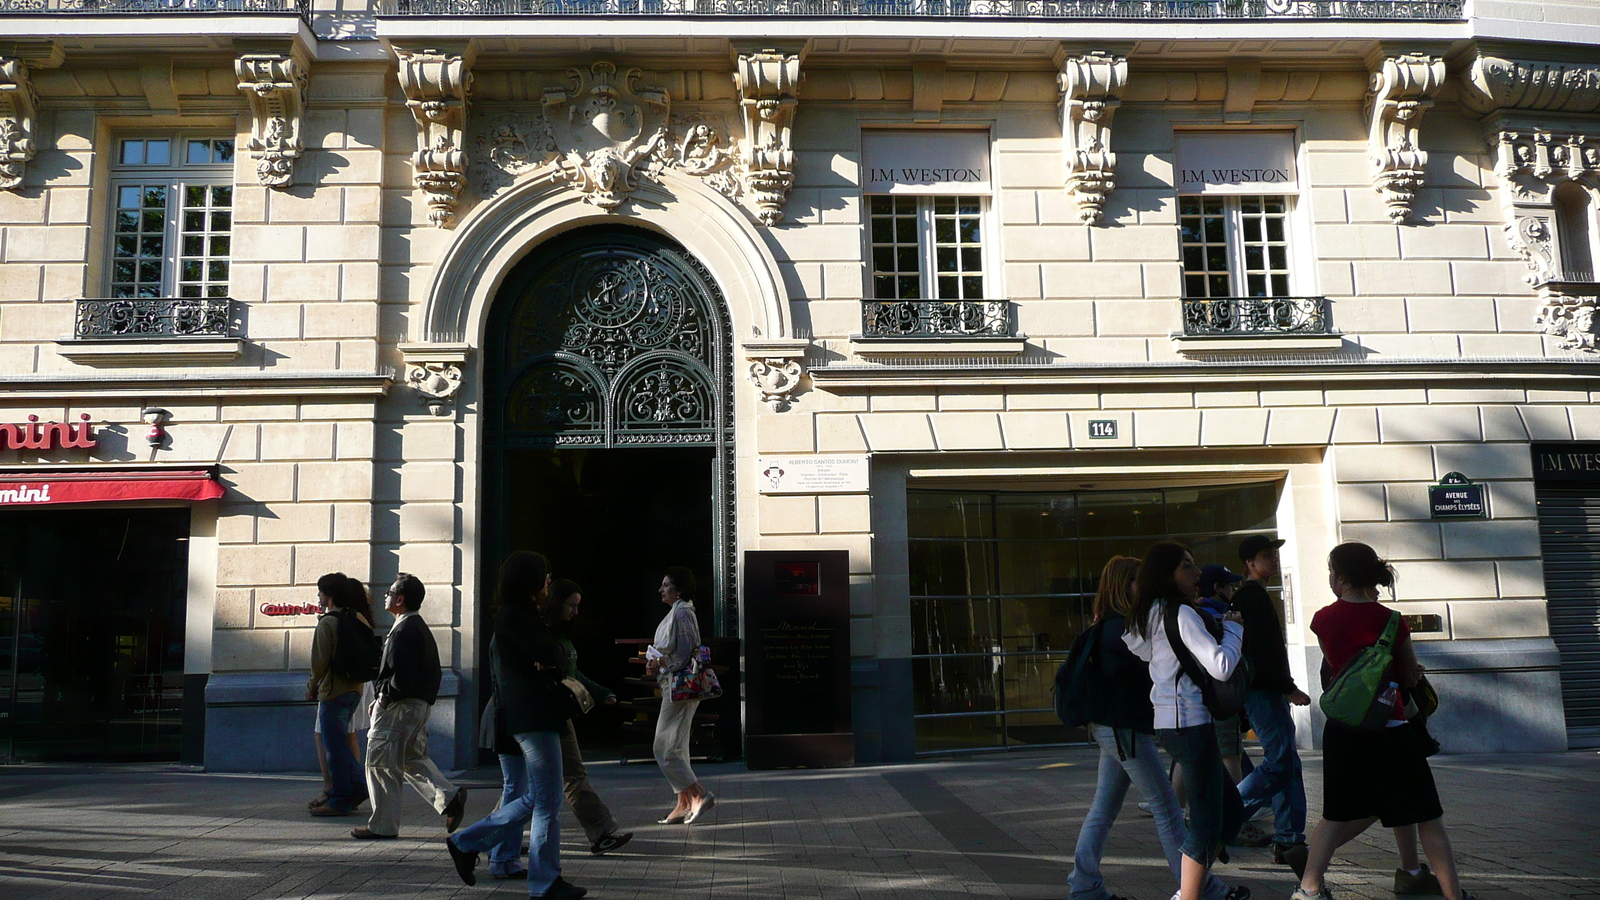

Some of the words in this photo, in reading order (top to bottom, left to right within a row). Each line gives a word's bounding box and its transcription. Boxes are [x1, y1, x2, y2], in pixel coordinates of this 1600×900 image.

[870, 168, 899, 183] J.M.
[902, 168, 981, 182] WESTON
[1181, 169, 1209, 184] J.M.
[1212, 168, 1288, 183] WESTON
[1092, 422, 1113, 436] 114
[1540, 453, 1566, 472] J.M.
[1458, 502, 1480, 511] ÉLYSÉES
